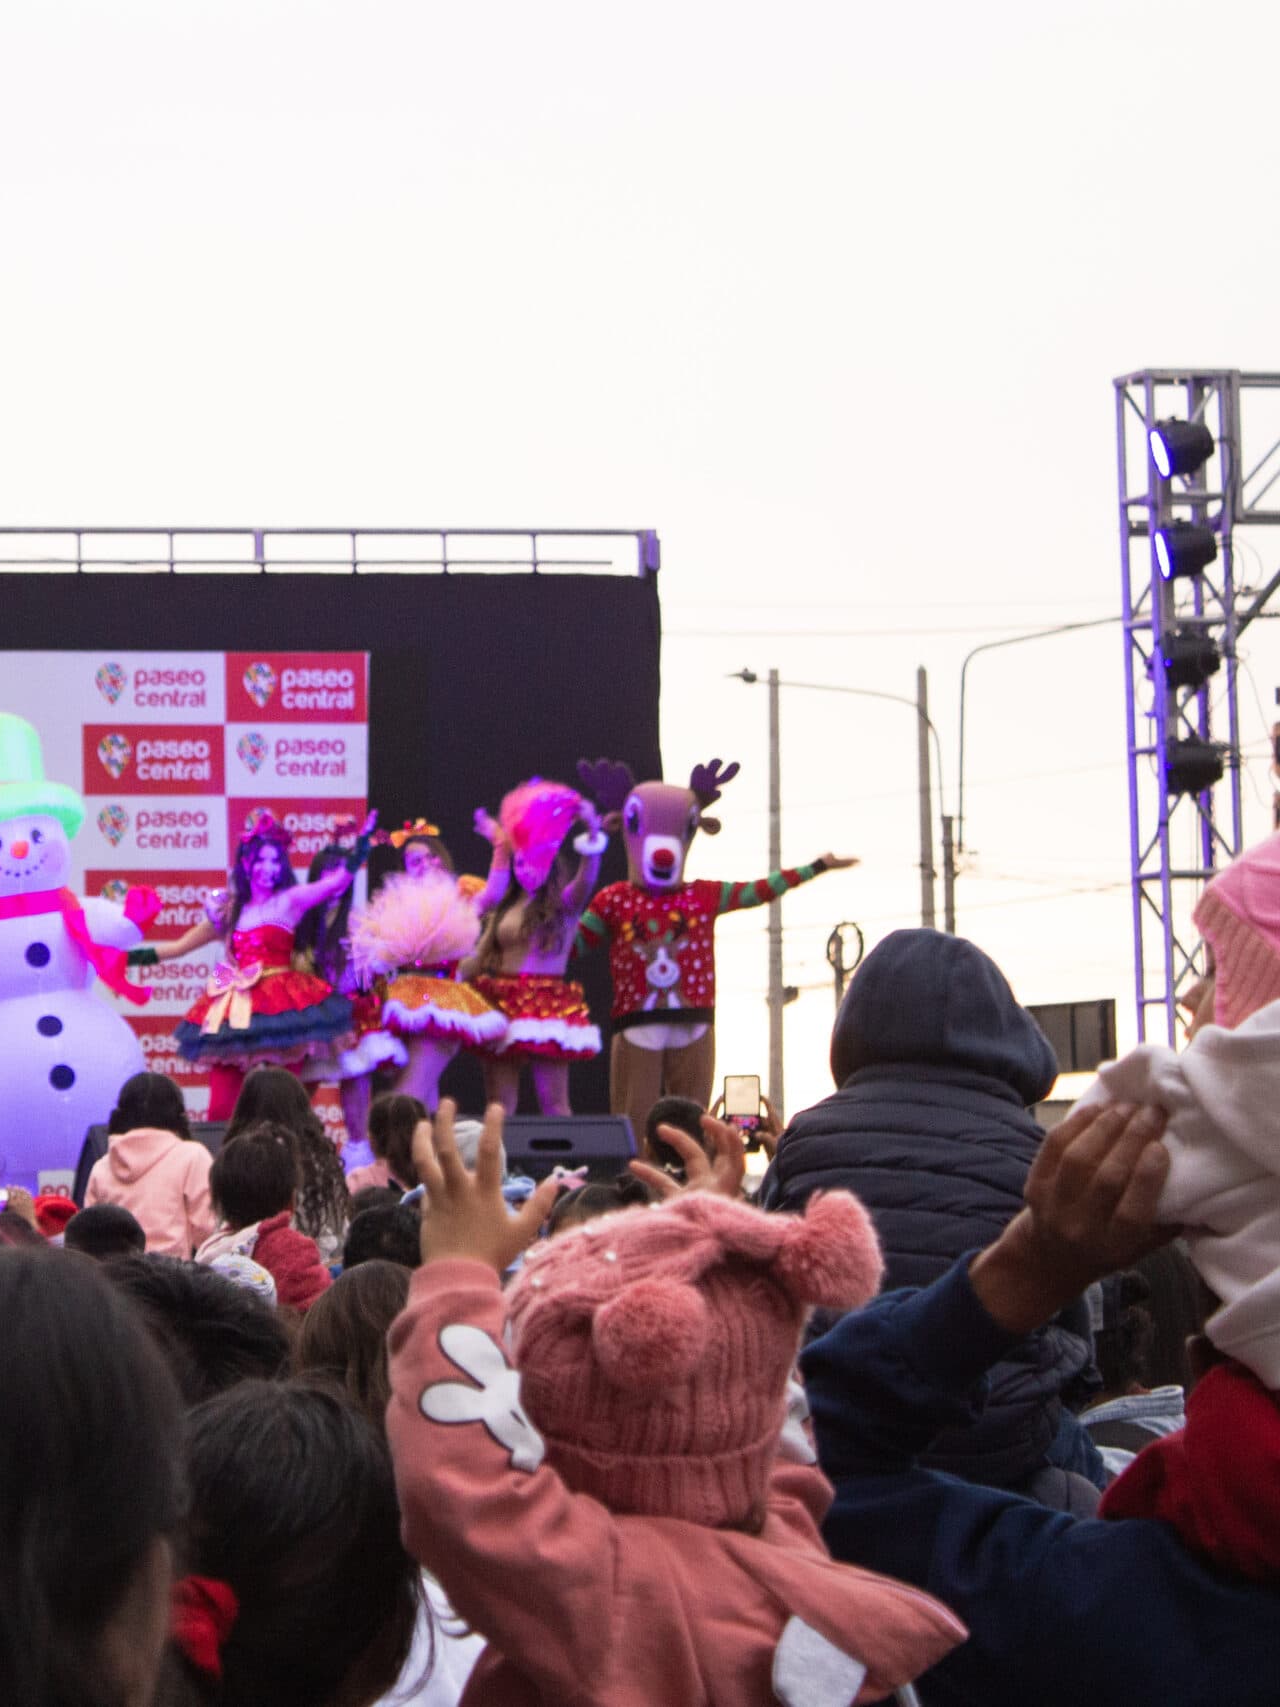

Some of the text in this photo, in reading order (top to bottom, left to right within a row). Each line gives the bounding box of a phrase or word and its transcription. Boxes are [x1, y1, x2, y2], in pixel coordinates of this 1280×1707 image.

[134, 669, 205, 689] paseo
[282, 668, 354, 690] paseo
[134, 688, 206, 707] central
[282, 688, 355, 709] central
[136, 739, 210, 761] paseo
[275, 738, 346, 758] paseo
[136, 759, 211, 781] central
[275, 757, 346, 777] central
[136, 810, 207, 830] paseo
[136, 830, 208, 849] central
[140, 963, 209, 984] paseo
